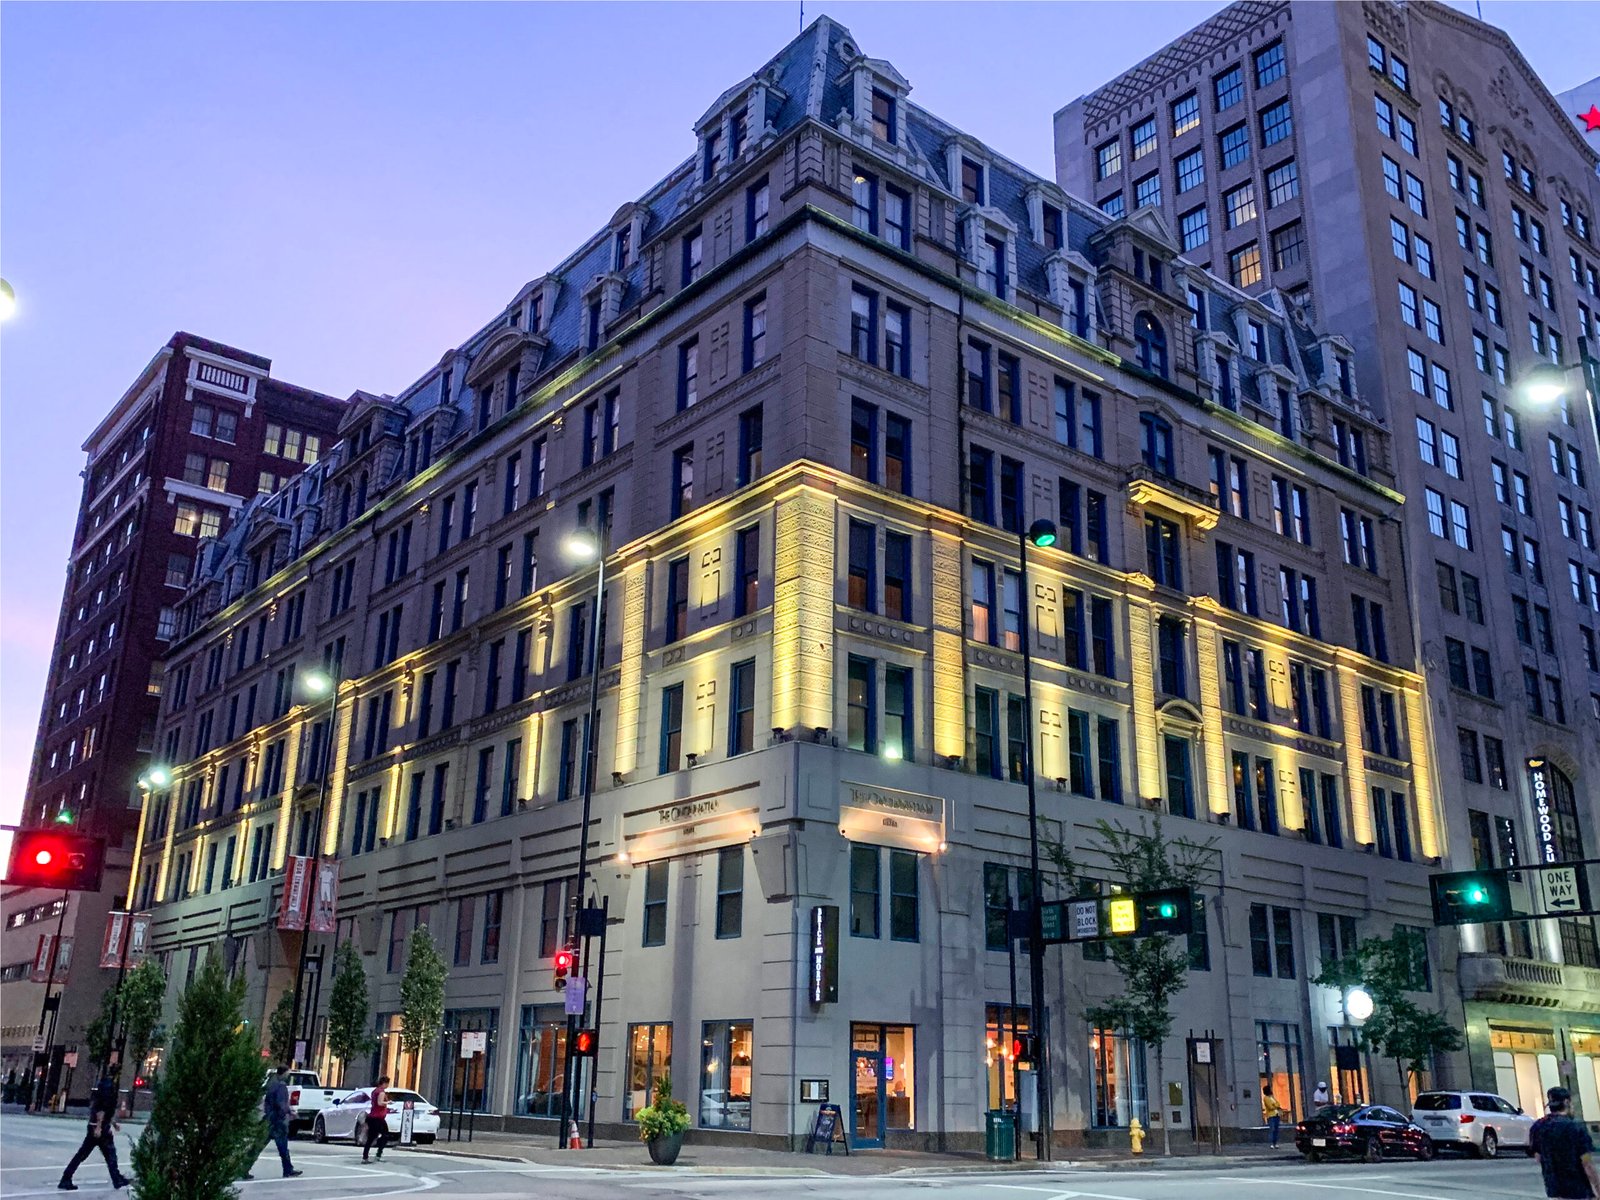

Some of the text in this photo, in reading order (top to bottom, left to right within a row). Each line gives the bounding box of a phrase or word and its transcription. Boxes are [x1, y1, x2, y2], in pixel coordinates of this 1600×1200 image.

[1534, 772, 1552, 841] HOMEWOOD
[1547, 871, 1571, 884] ONE
[1549, 884, 1572, 897] WAY
[1077, 905, 1096, 915] DO NOT
[1077, 917, 1096, 927] BLOCK
